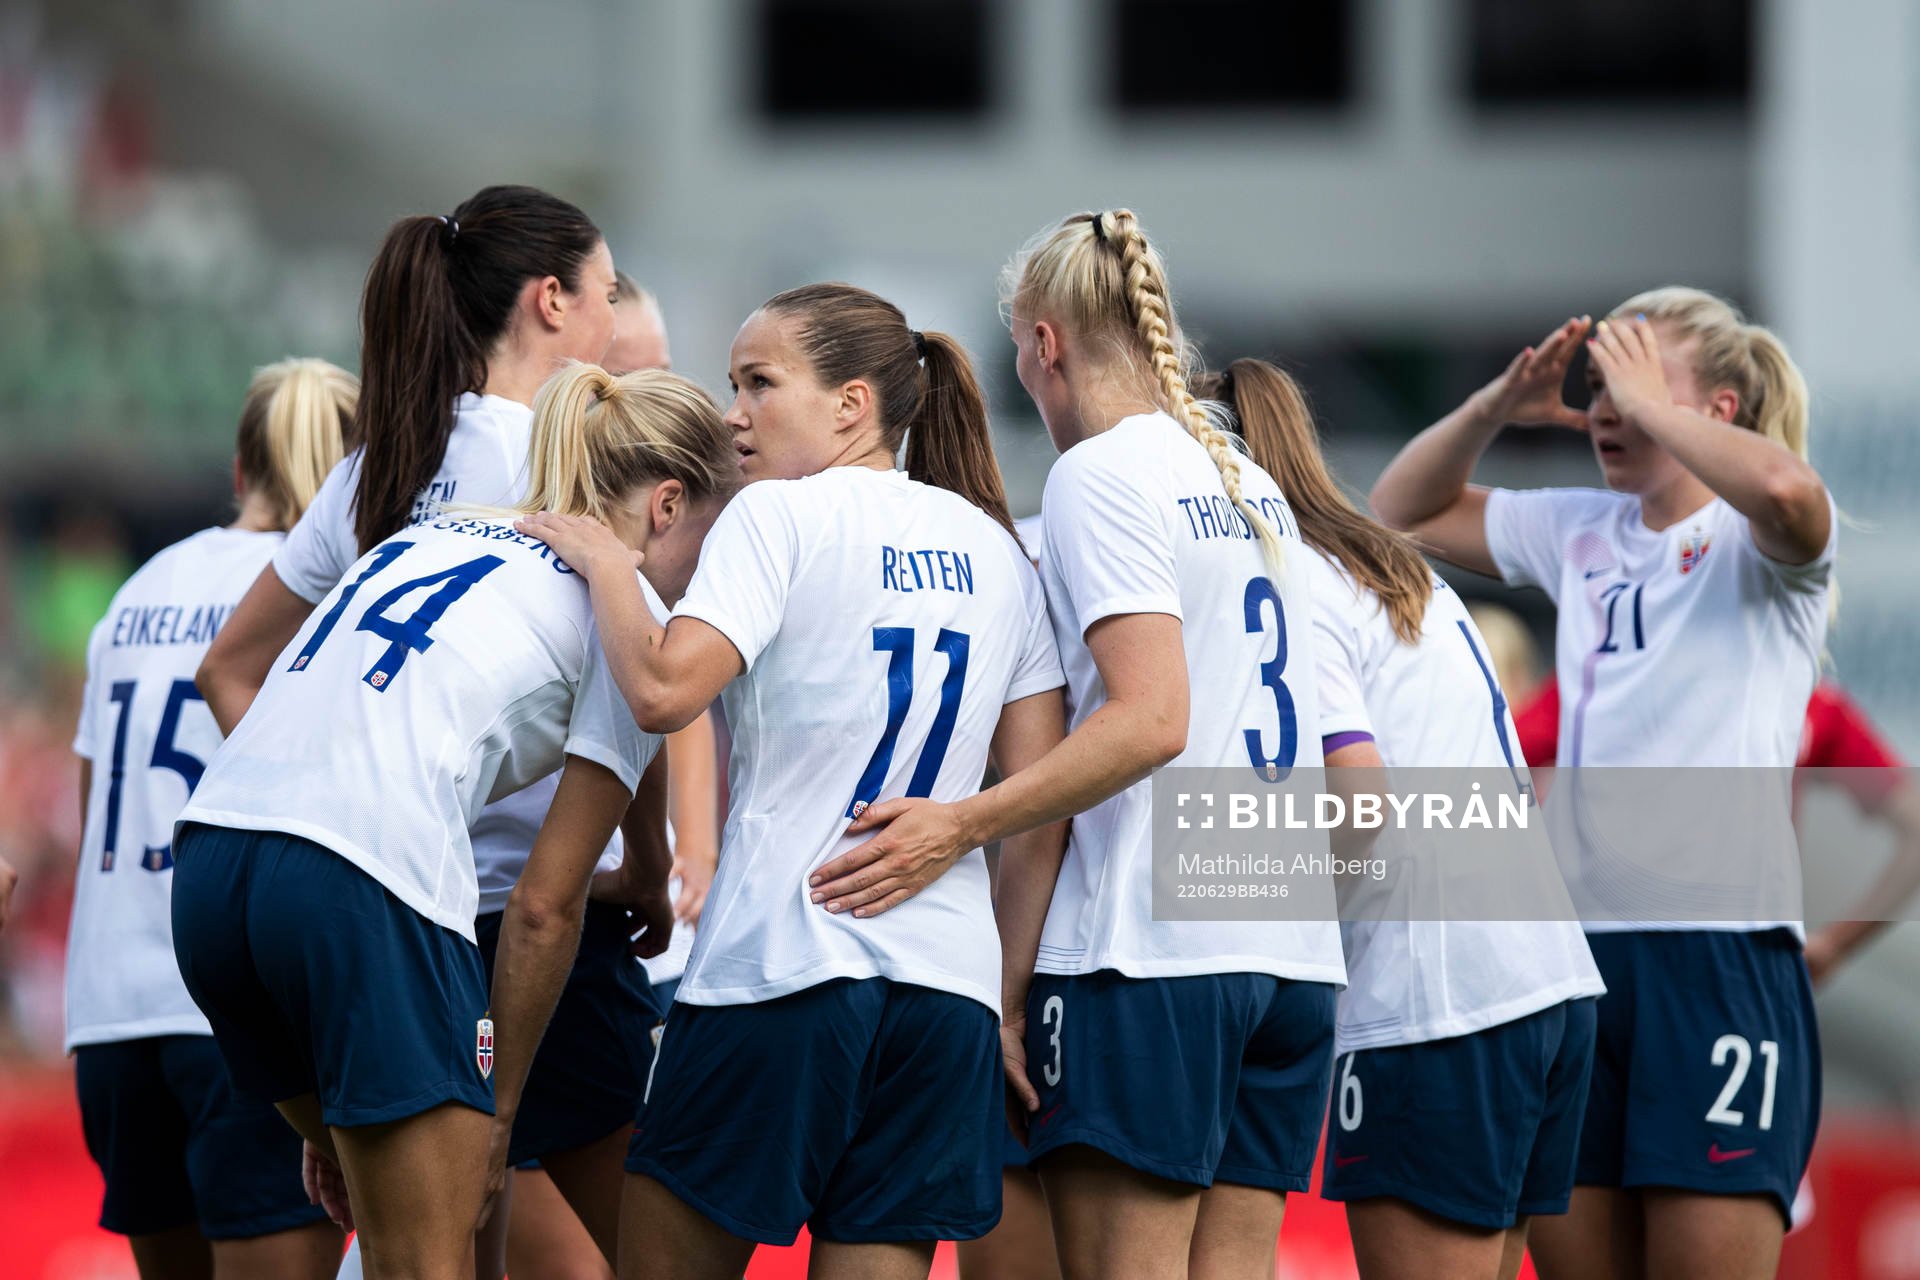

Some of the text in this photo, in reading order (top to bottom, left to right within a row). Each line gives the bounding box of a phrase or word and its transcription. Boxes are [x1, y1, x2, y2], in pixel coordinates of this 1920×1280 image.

[287, 540, 507, 693] 14
[882, 545, 974, 595] REITEN
[1597, 581, 1645, 653] 21
[111, 604, 235, 648] EIKELAN
[845, 627, 971, 819] 11
[1242, 576, 1299, 784] 3
[101, 679, 206, 871] 15
[1042, 994, 1064, 1088] 3
[1705, 1034, 1779, 1131] 21
[1338, 1052, 1363, 1132] 6
